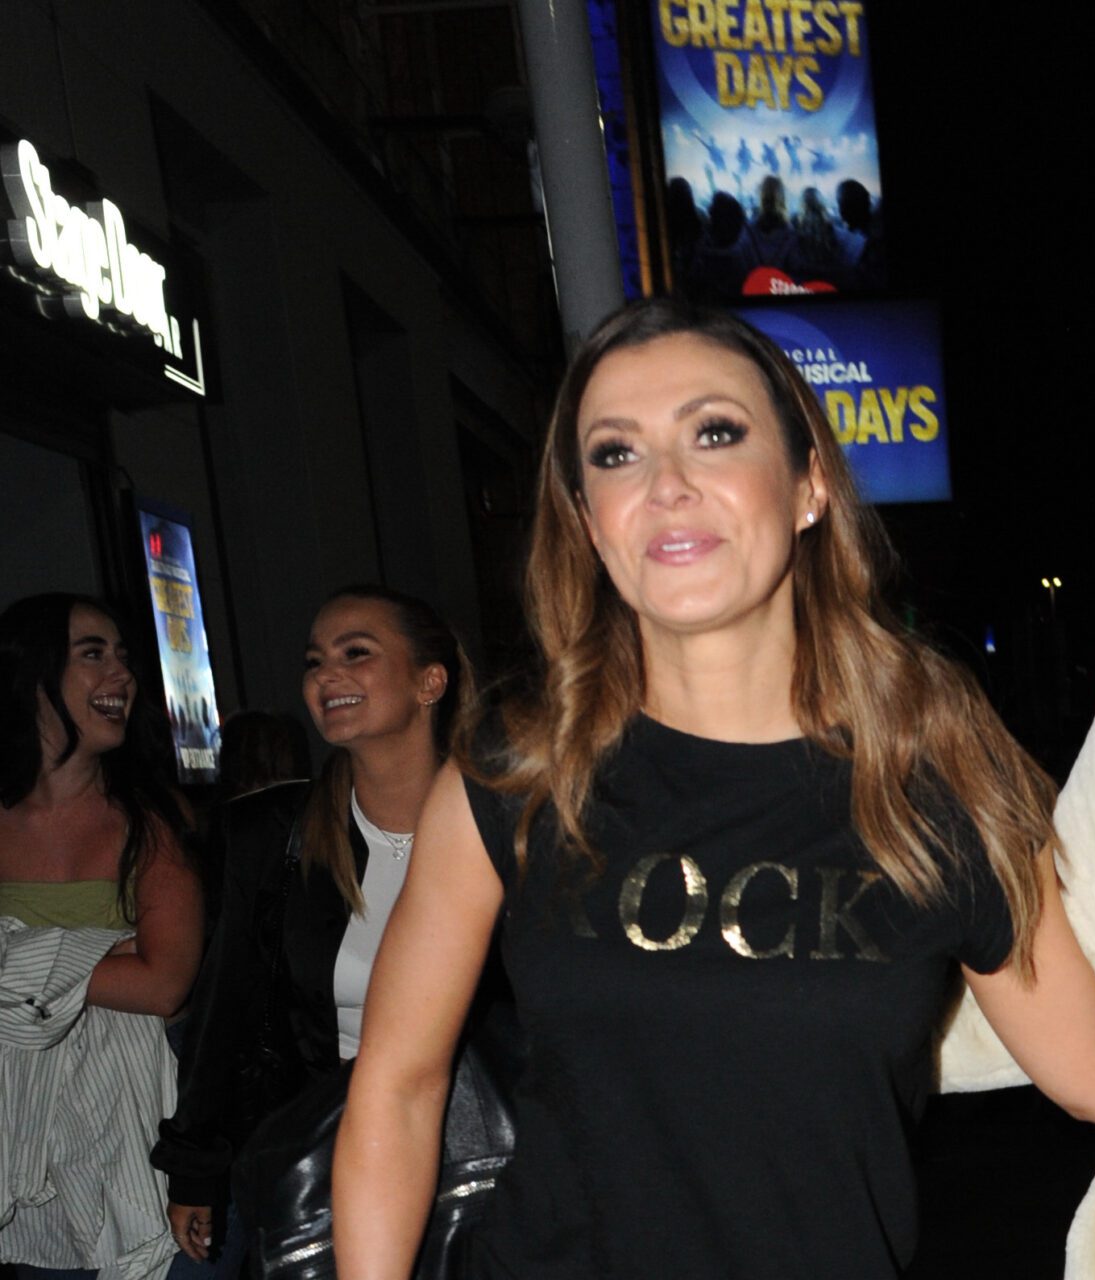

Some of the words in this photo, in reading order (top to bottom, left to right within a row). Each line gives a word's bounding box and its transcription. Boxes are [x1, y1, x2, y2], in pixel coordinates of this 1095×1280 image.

[658, 0, 864, 57] GREATEST
[713, 50, 824, 112] DAYS
[824, 385, 940, 446] DAYS
